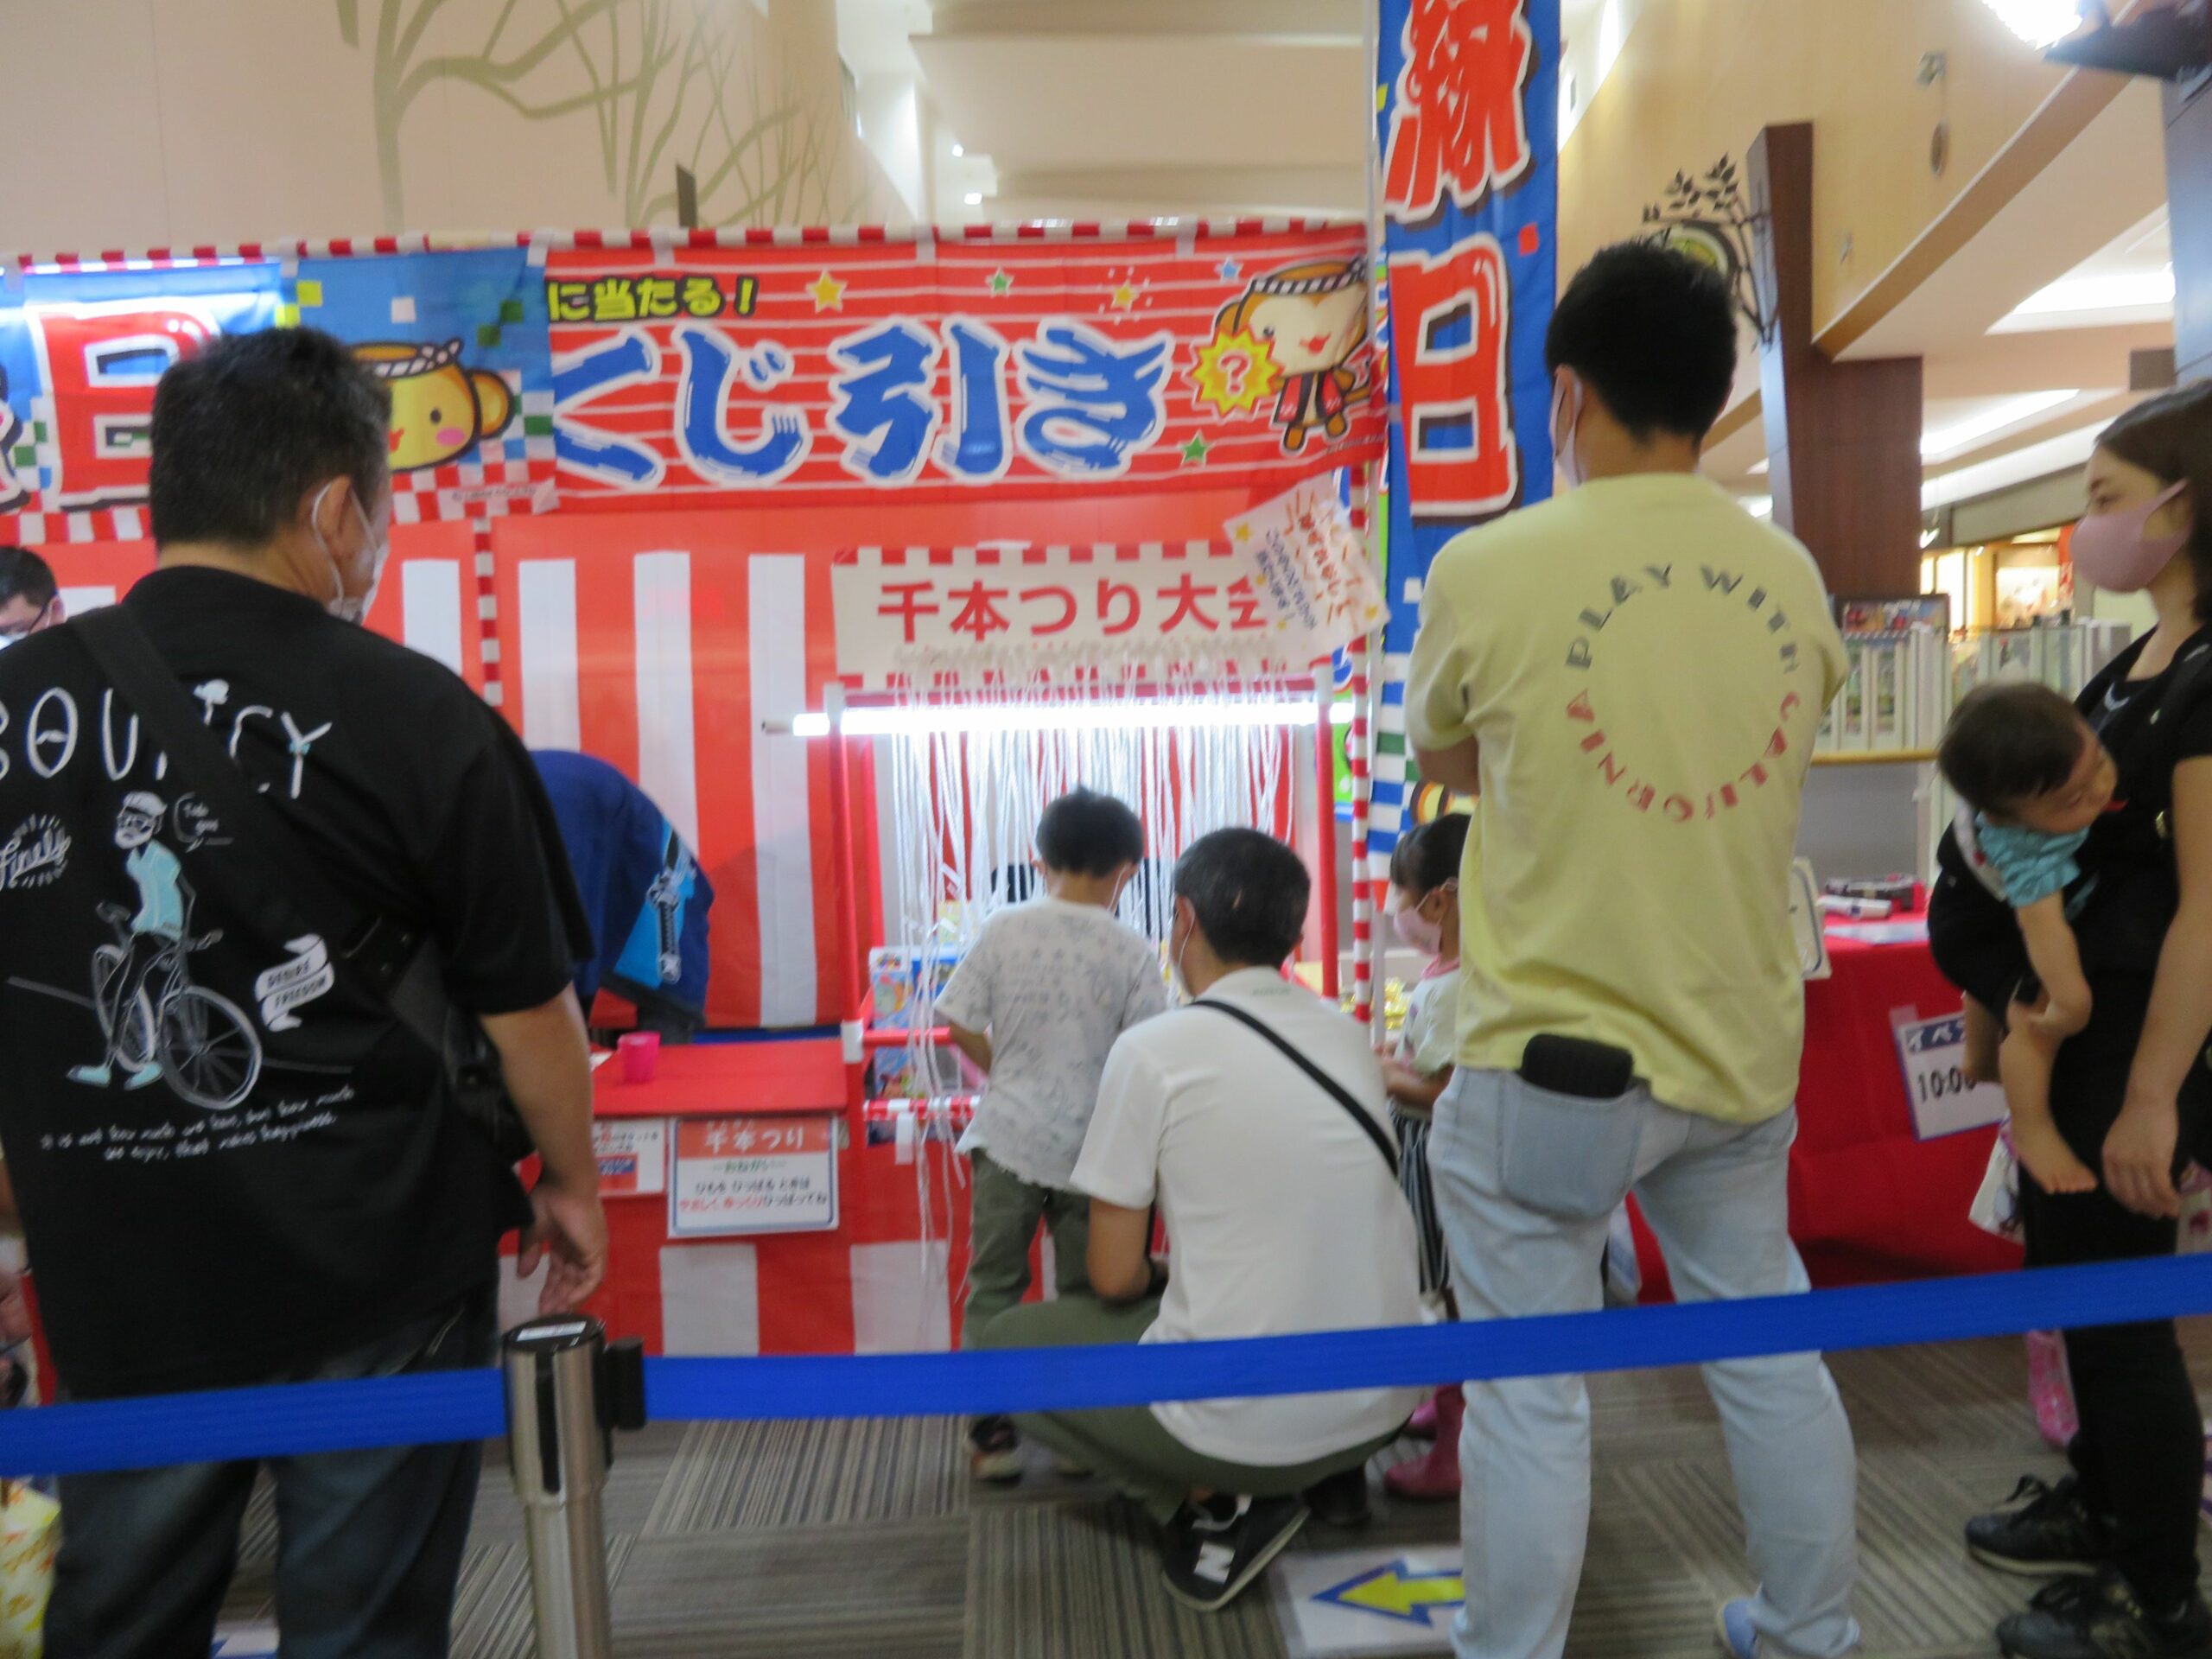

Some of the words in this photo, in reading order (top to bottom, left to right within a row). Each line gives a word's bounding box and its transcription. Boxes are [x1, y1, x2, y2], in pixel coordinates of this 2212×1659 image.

[553, 316, 1173, 486] くじ引き
[1564, 563, 1673, 671] PLAY
